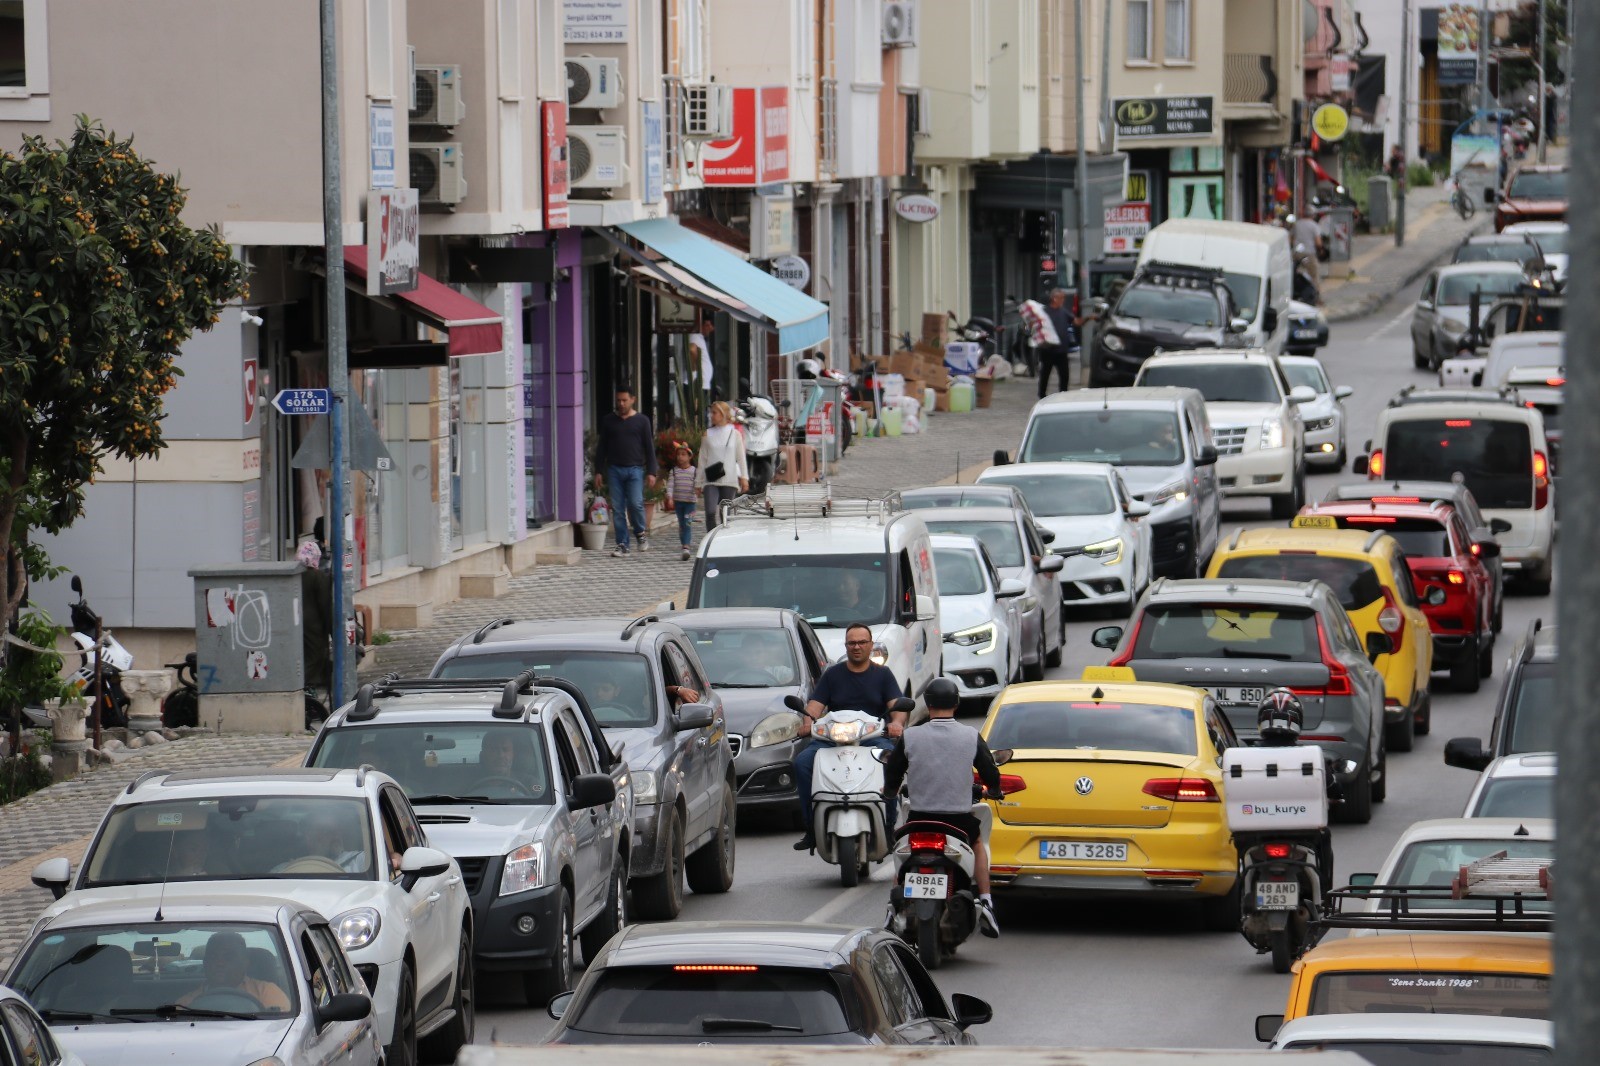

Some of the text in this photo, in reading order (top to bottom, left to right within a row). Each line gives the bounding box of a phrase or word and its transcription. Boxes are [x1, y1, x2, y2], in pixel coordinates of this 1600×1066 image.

[293, 391, 318, 399] 178.
[286, 398, 325, 407] SOKAK
[1241, 688, 1262, 702] 850
[1254, 804, 1307, 816] bu_kurye
[1047, 843, 1125, 858] 48 T 3285
[922, 887, 936, 896] 76
[1259, 883, 1272, 894] 48
[1266, 895, 1287, 905] 263
[1416, 978, 1447, 986] Sanki
